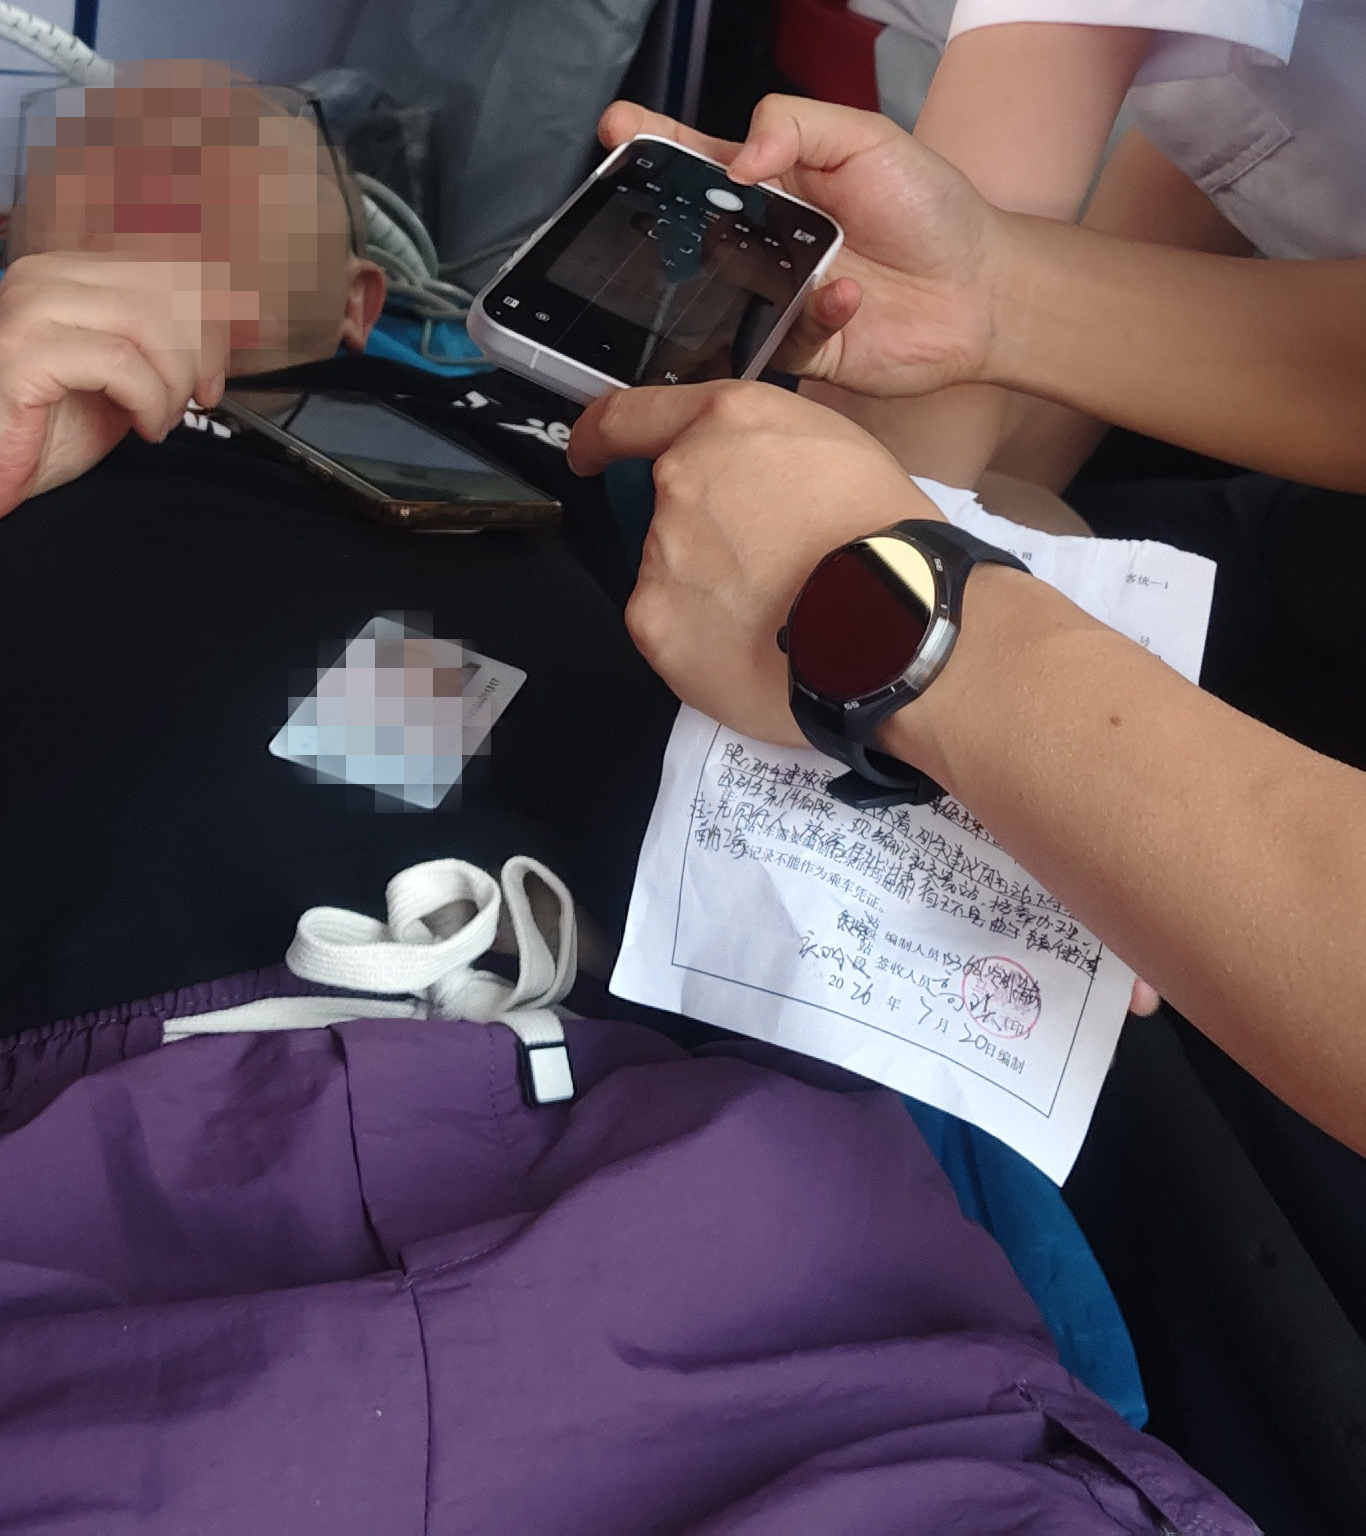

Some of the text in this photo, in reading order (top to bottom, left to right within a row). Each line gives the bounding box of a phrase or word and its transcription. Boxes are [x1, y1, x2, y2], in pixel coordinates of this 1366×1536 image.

[885, 931, 939, 961] 编制人员
[875, 956, 932, 992] 签收人员
